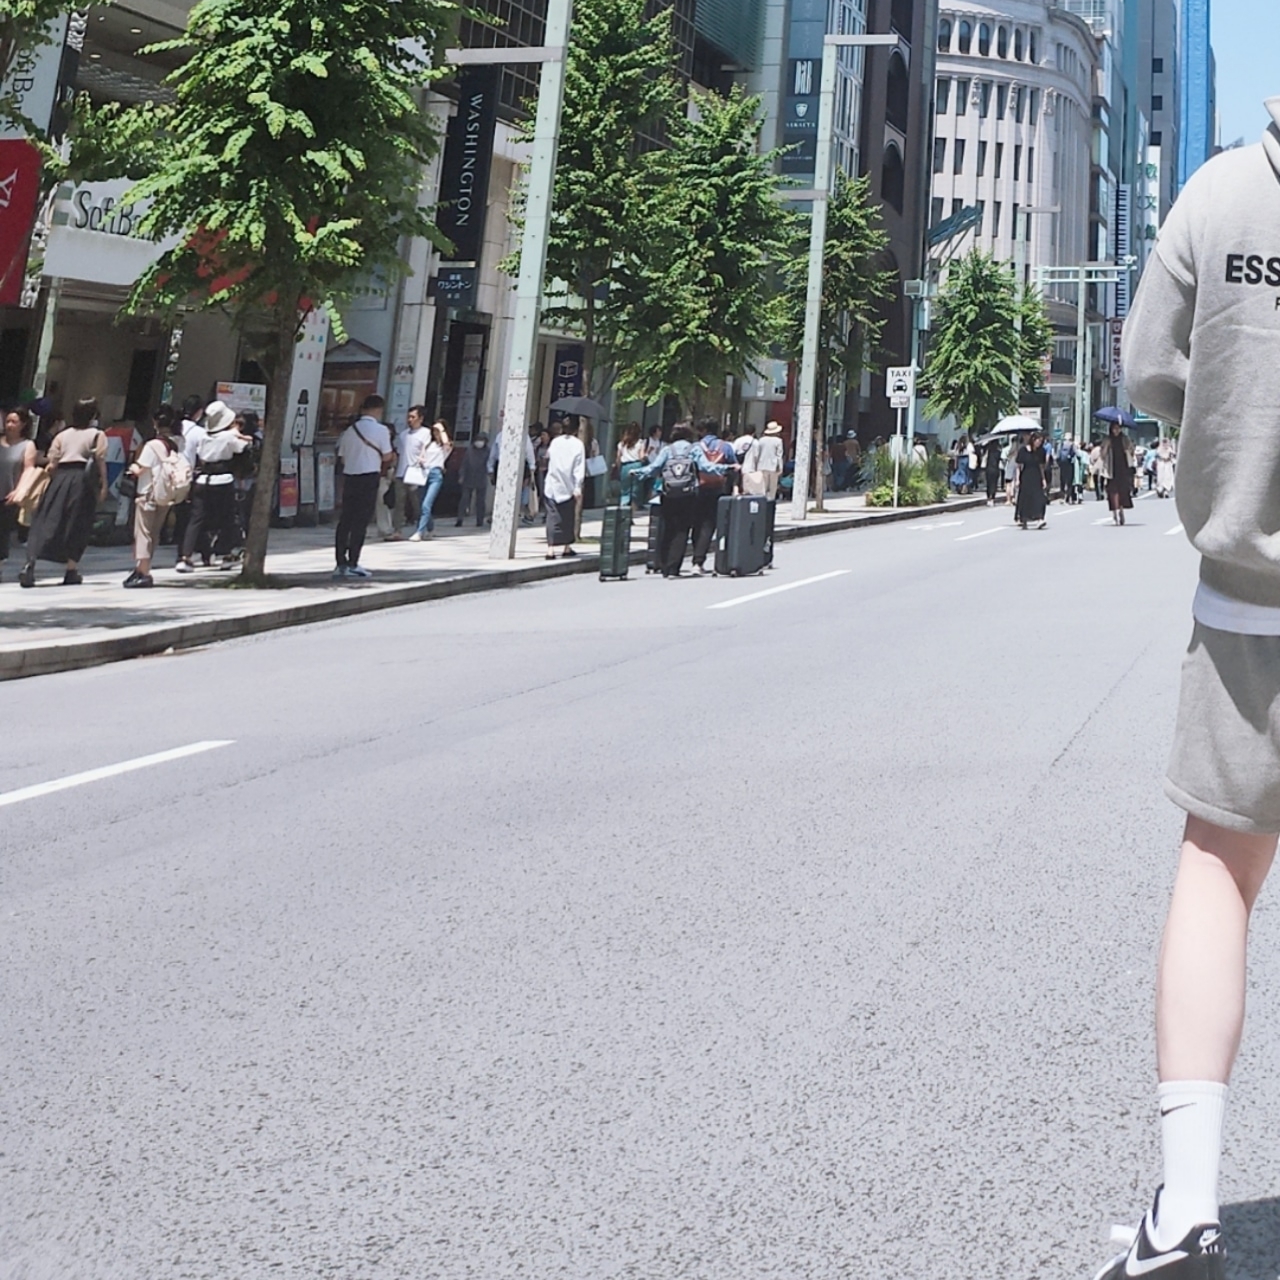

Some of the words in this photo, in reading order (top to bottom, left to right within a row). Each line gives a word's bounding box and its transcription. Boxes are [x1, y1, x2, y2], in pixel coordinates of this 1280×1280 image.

[456, 93, 484, 226] WASHINGTON
[437, 280, 472, 290] ワシントン
[891, 370, 912, 378] TAXI
